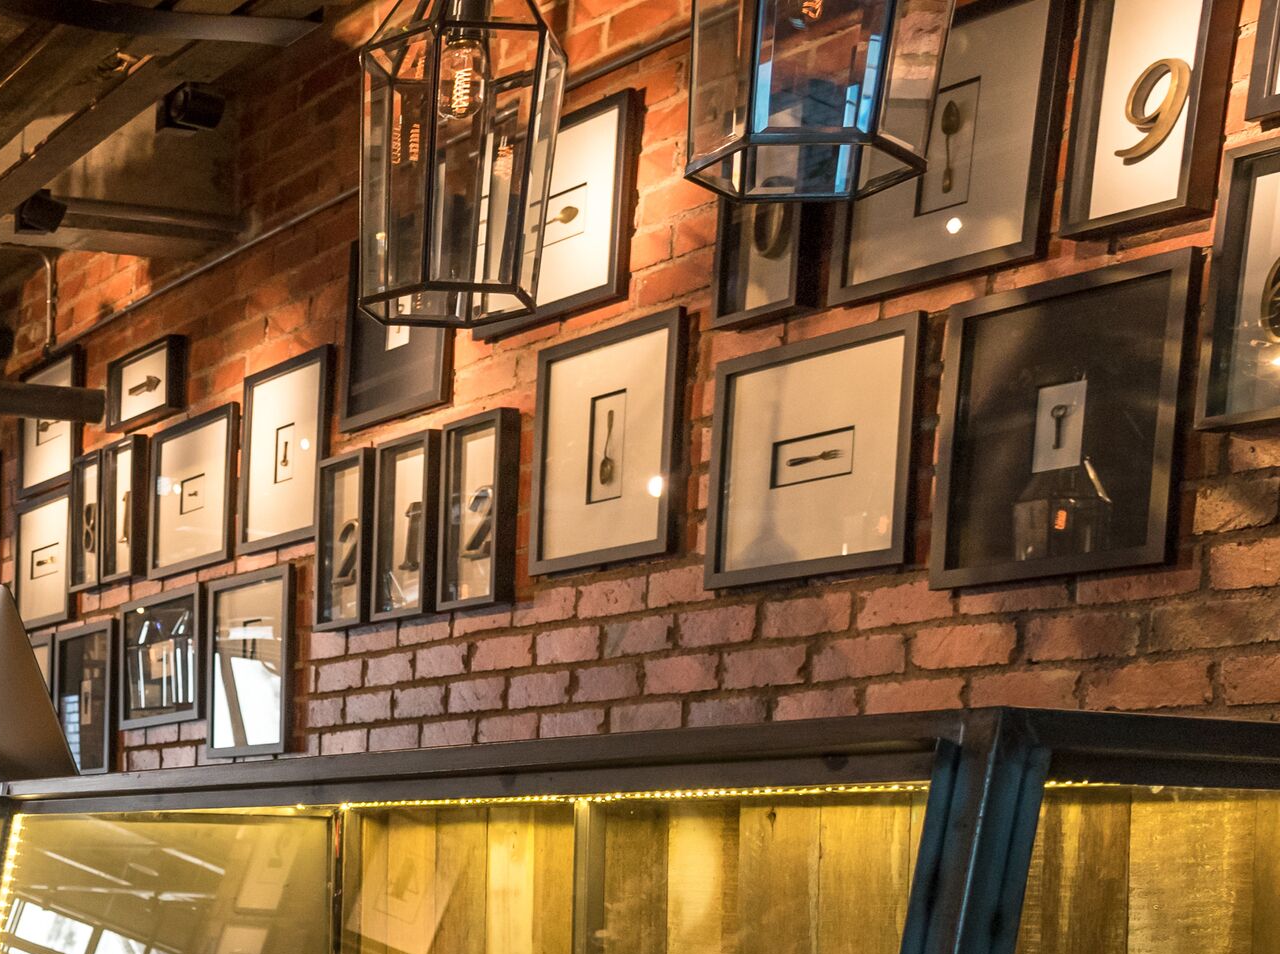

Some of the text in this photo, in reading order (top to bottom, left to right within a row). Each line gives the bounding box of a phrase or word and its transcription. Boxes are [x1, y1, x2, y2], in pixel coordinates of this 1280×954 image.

[1114, 58, 1192, 163] 9
[331, 518, 359, 586] 2
[460, 485, 495, 560] 2
